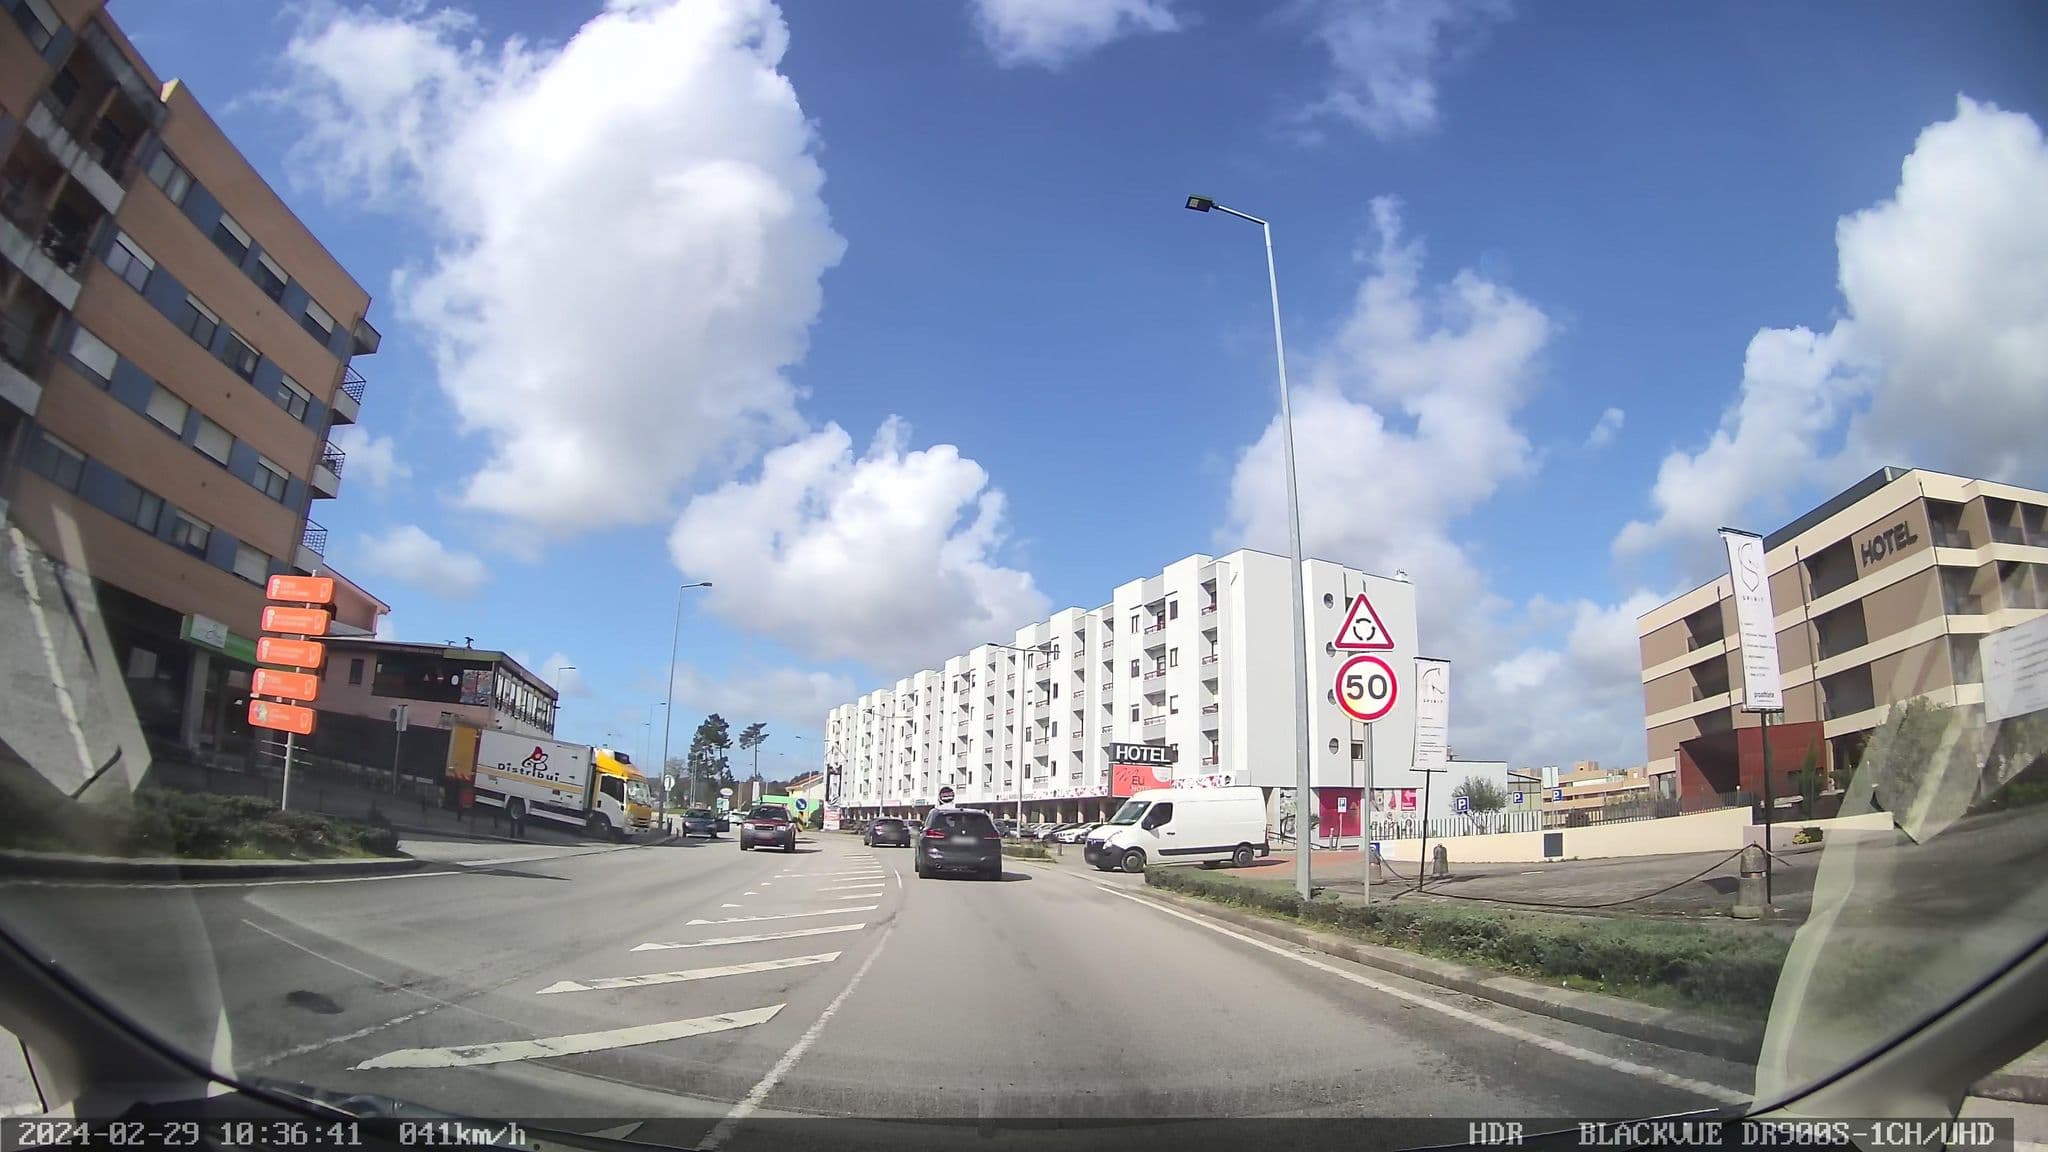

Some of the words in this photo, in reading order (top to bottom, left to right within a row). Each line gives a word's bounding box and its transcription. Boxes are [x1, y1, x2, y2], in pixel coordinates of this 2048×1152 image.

[1860, 520, 1919, 567] HOTEL
[1346, 673, 1388, 700] 50
[1116, 745, 1171, 762] HOTEL
[498, 763, 559, 781] Distribui
[1131, 775, 1145, 785] EU
[1457, 799, 1466, 810] P
[1514, 793, 1521, 803] P
